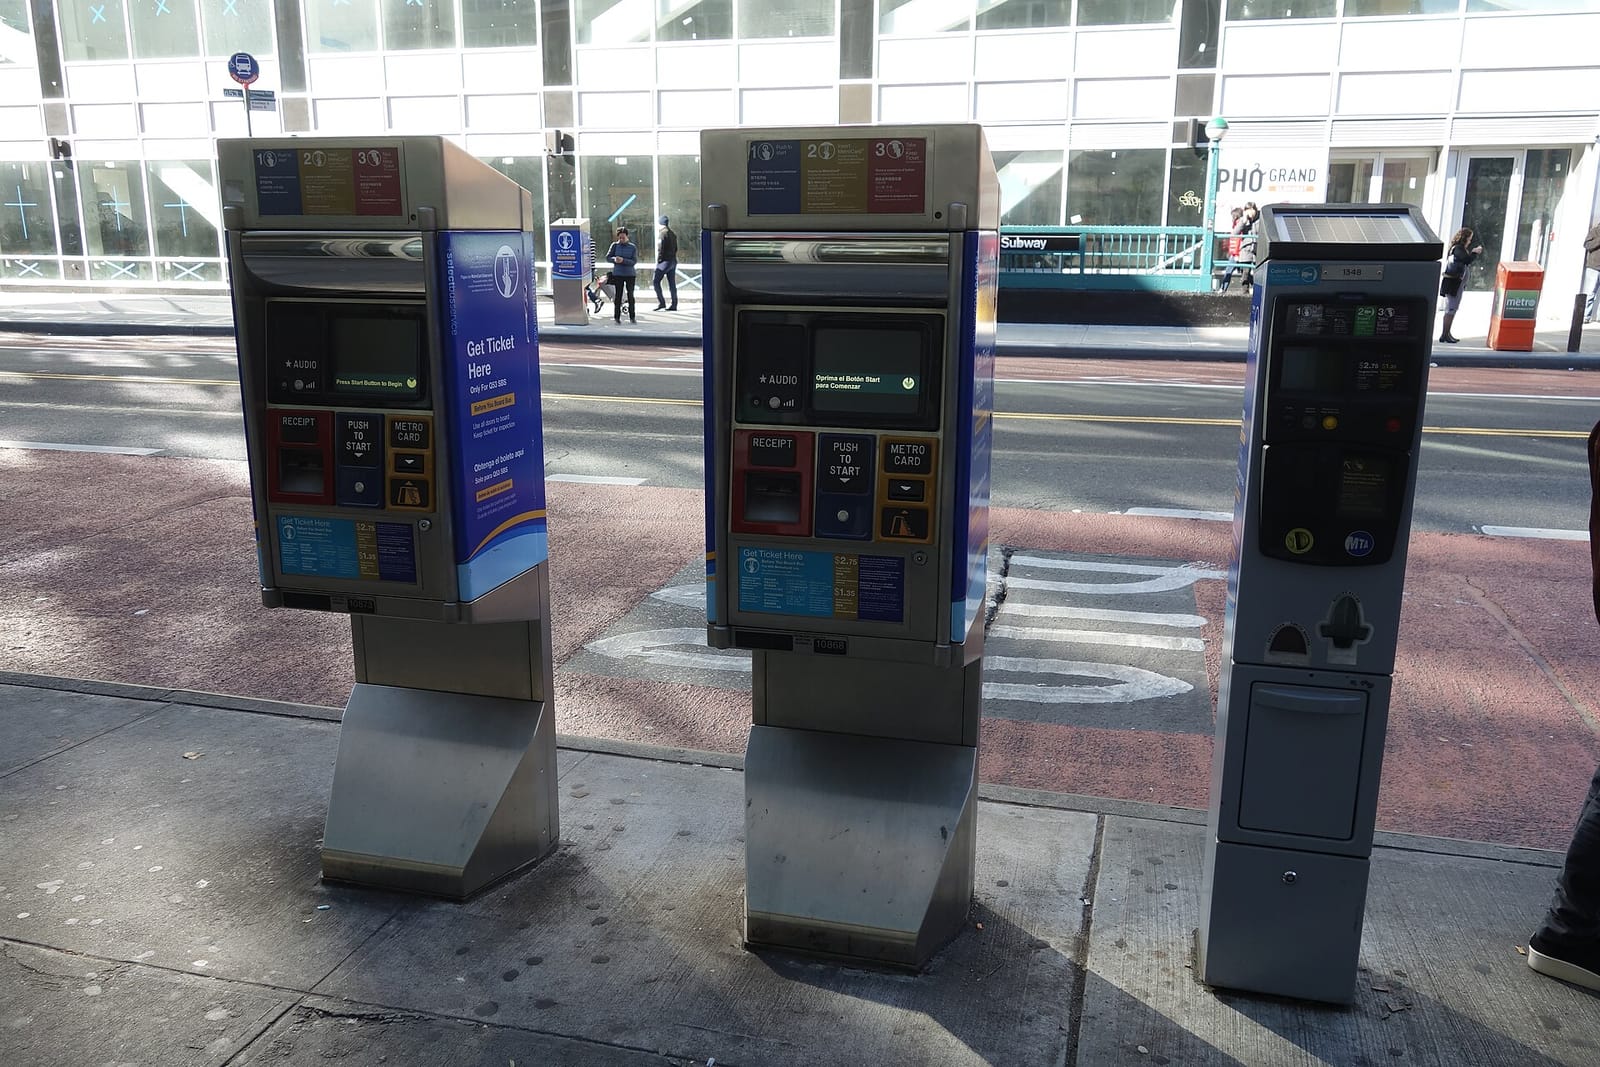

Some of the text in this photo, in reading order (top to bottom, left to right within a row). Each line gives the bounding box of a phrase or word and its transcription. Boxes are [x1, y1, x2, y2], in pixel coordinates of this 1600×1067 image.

[807, 143, 817, 158] 2
[875, 143, 885, 157] 3
[257, 153, 263, 165] 1
[303, 153, 312, 165] 2
[358, 152, 367, 164] 3
[1269, 168, 1317, 182] GRAND
[1000, 238, 1048, 250] Subway
[1506, 298, 1536, 307] metro
[1357, 307, 1364, 315] 2
[1377, 308, 1385, 316] 3
[467, 335, 515, 357] Get Ticket
[293, 360, 317, 369] AUDIO
[468, 362, 492, 379] Here
[364, 379, 381, 387] Button
[387, 380, 403, 388] Begin
[768, 375, 798, 385] AUDIO
[815, 374, 838, 383] Oprima
[846, 375, 865, 383] Botón
[470, 385, 480, 394] Only
[480, 383, 488, 391] For
[830, 382, 861, 390] Comenzar
[282, 416, 315, 427] RECEIPT
[348, 420, 369, 430] PUSH
[394, 421, 424, 432] METRO
[353, 431, 364, 440] TO
[397, 432, 420, 442] CARD
[345, 442, 372, 451] START
[752, 437, 793, 449] RECEIPT
[833, 442, 859, 452] PUSH
[890, 444, 926, 455] METRO
[839, 454, 852, 464] TO
[894, 456, 921, 467] CARD
[473, 460, 495, 472] Obtenga
[829, 466, 861, 476] START
[281, 516, 294, 525] Get
[295, 518, 314, 526] Ticket
[743, 549, 804, 561] Get Ticket Here
[834, 555, 859, 566] $2.75
